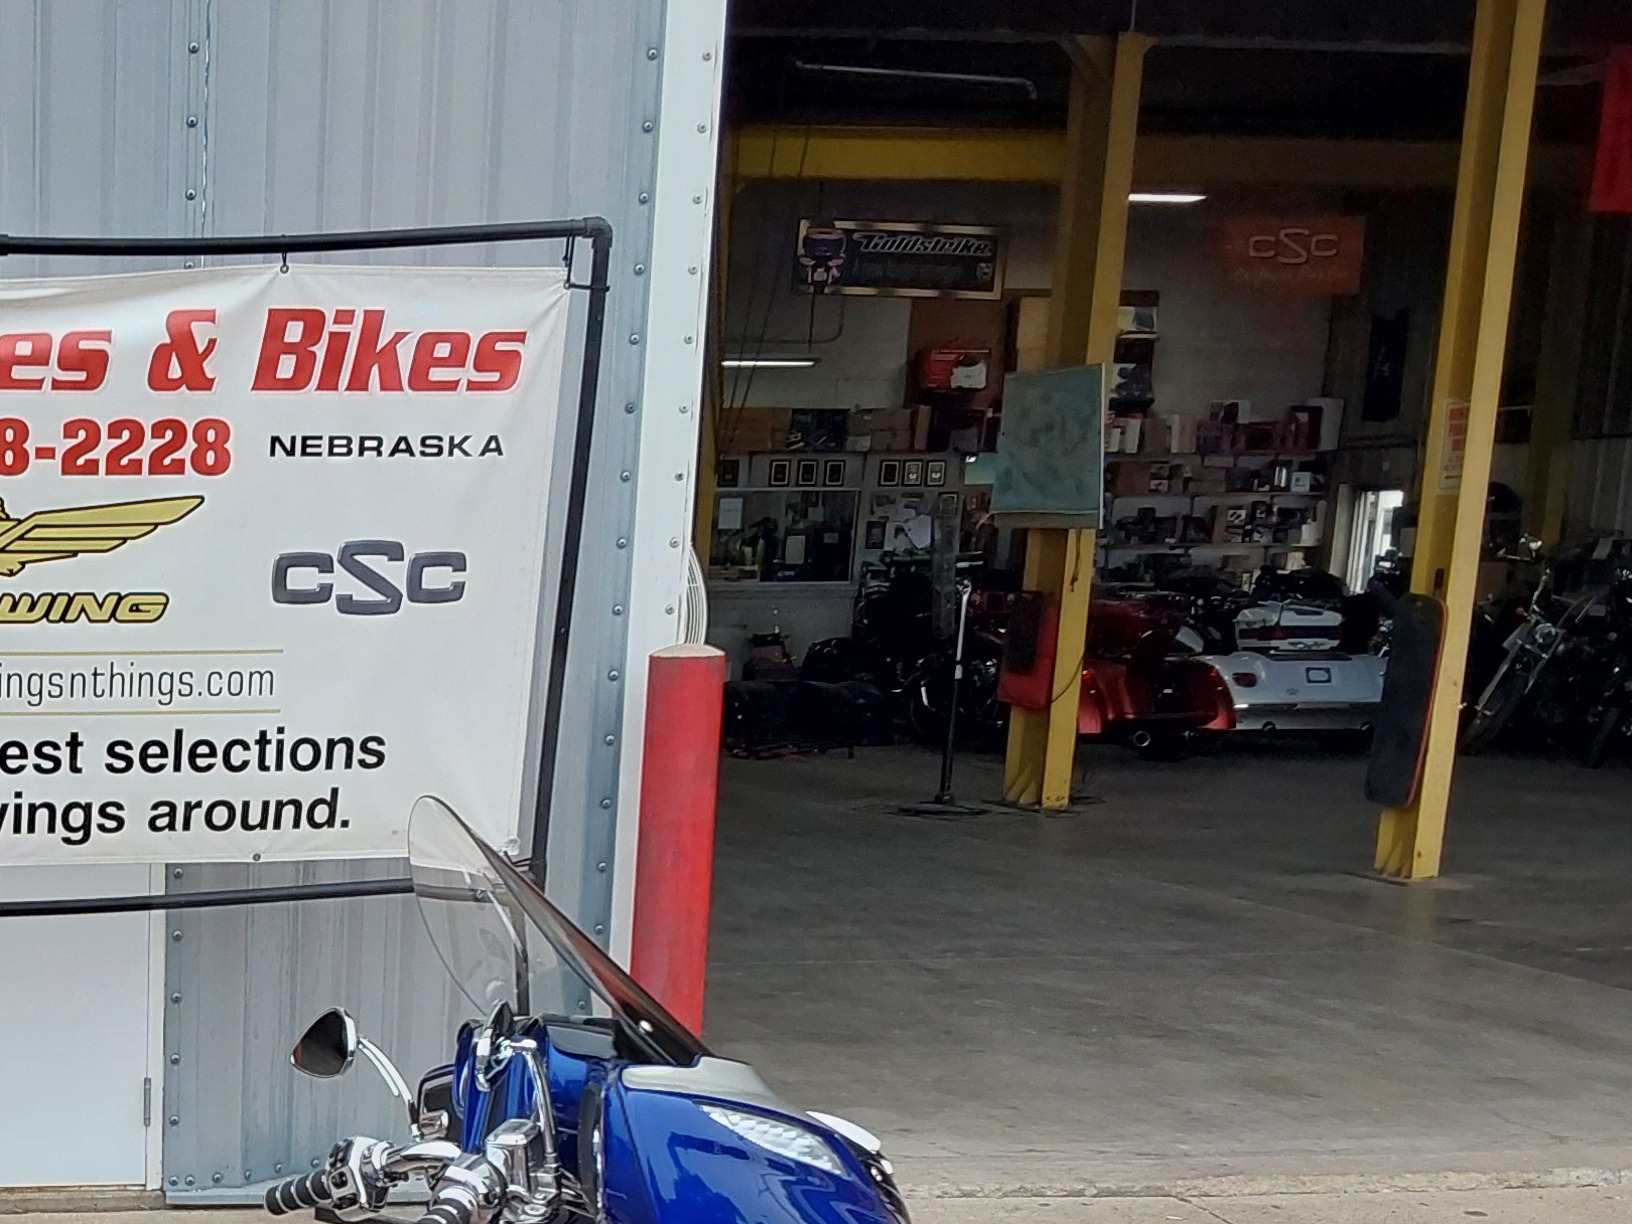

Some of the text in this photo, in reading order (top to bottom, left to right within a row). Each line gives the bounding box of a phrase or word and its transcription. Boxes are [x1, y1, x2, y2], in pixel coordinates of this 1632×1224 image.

[148, 309, 218, 392] &
[251, 308, 528, 392] Bikes
[269, 434, 504, 458] NEBRASKA
[104, 726, 386, 774] selections
[147, 786, 350, 833] around.
